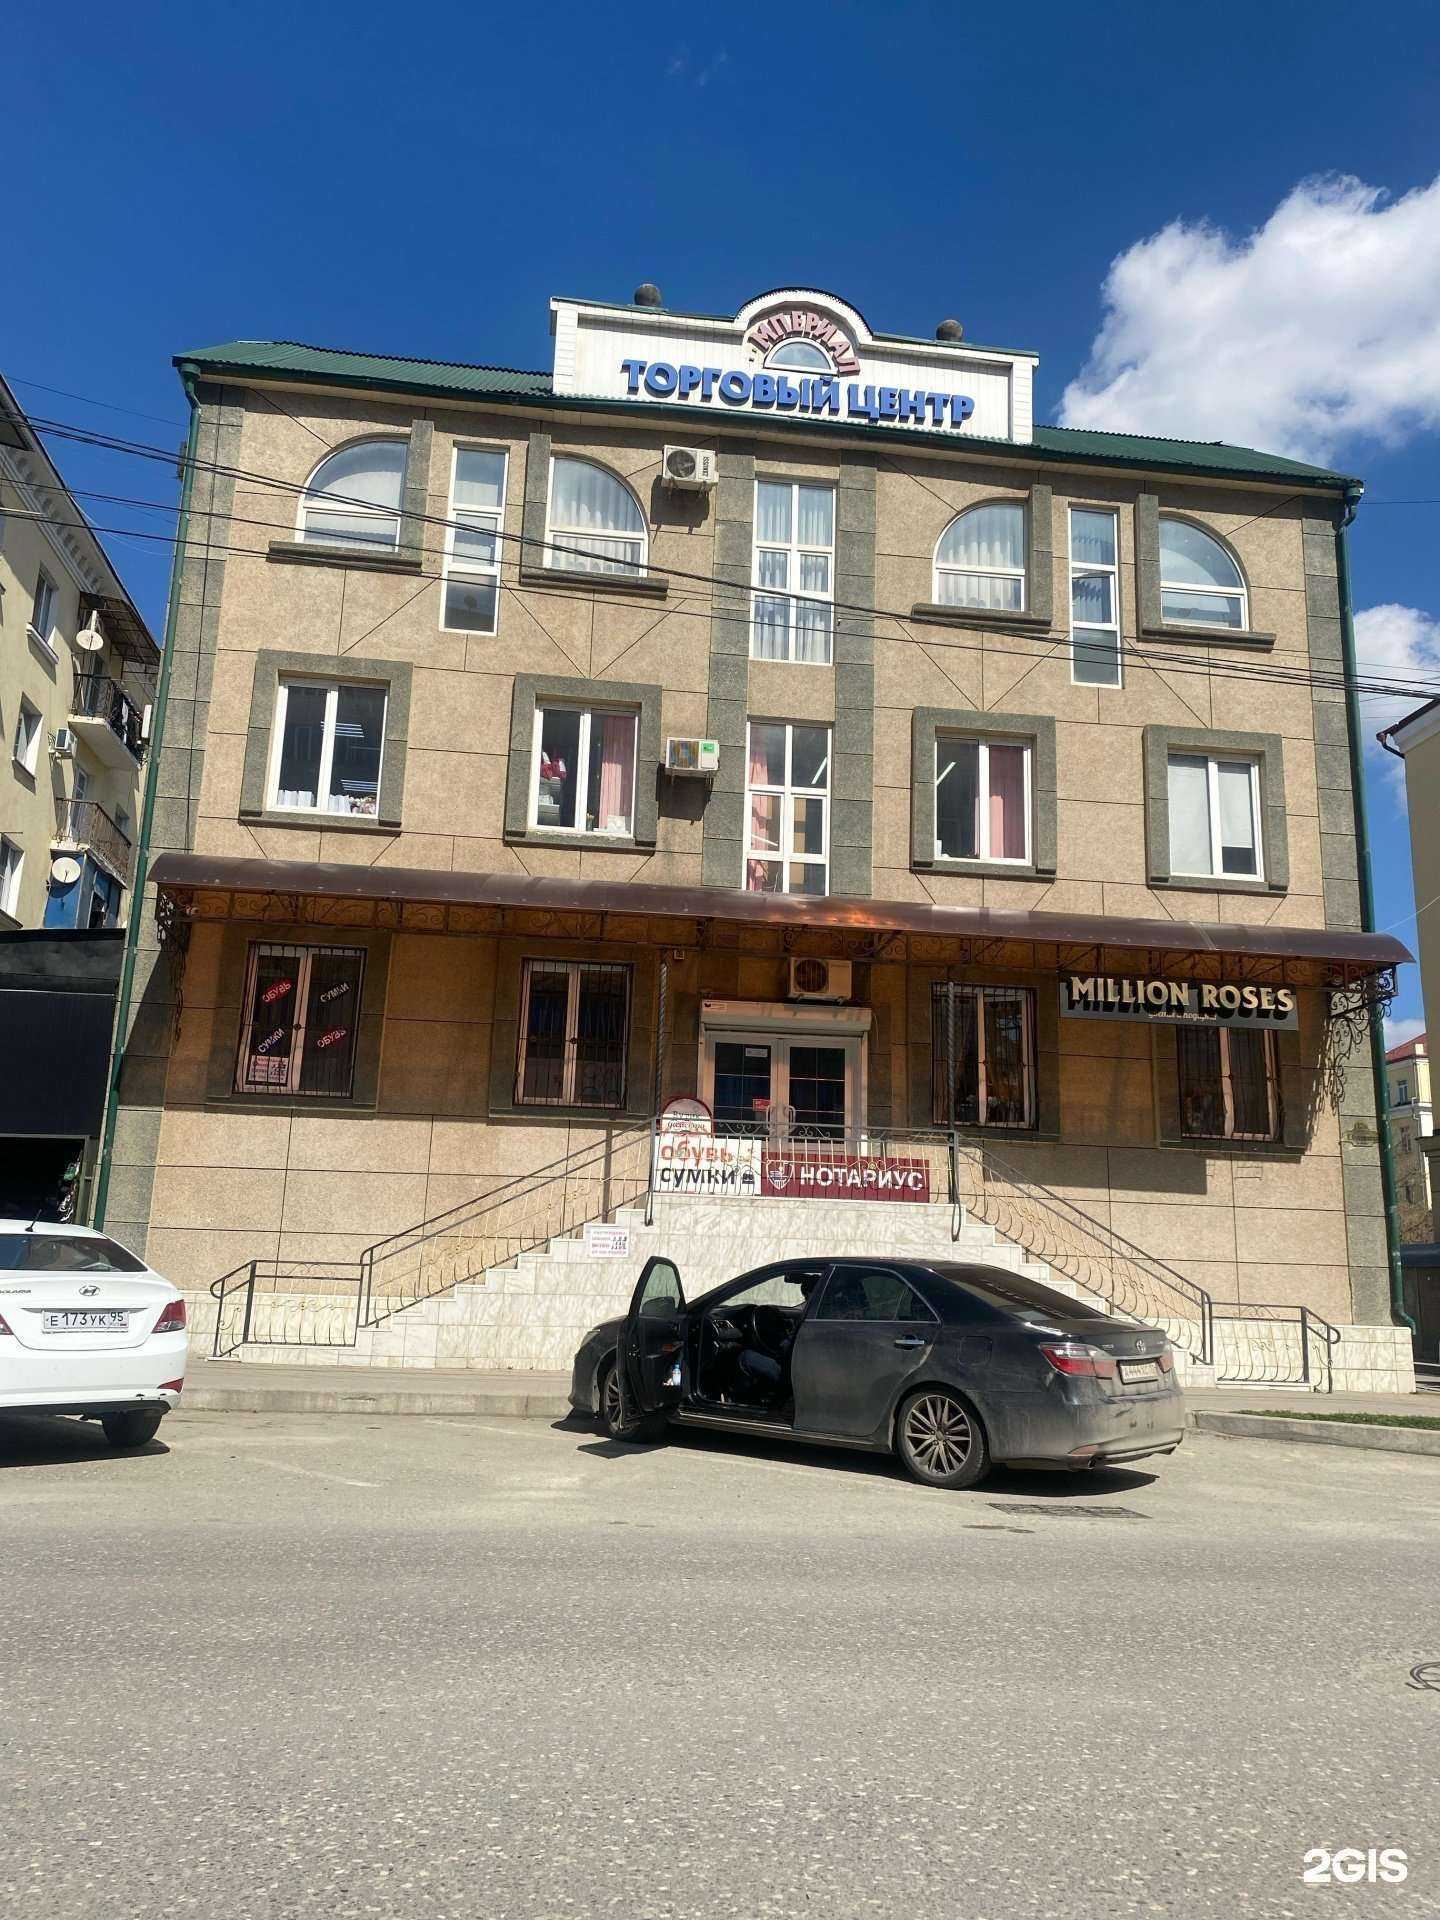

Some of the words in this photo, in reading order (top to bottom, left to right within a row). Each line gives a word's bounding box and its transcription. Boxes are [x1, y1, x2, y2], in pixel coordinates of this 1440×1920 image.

[621, 359, 842, 417] ТОРГОВЫЙ
[846, 383, 976, 430] ЦЕНТР
[1069, 976, 1190, 1006] MILLION
[1202, 984, 1295, 1012] ROSES
[800, 1166, 923, 1191] НОТАРИУС
